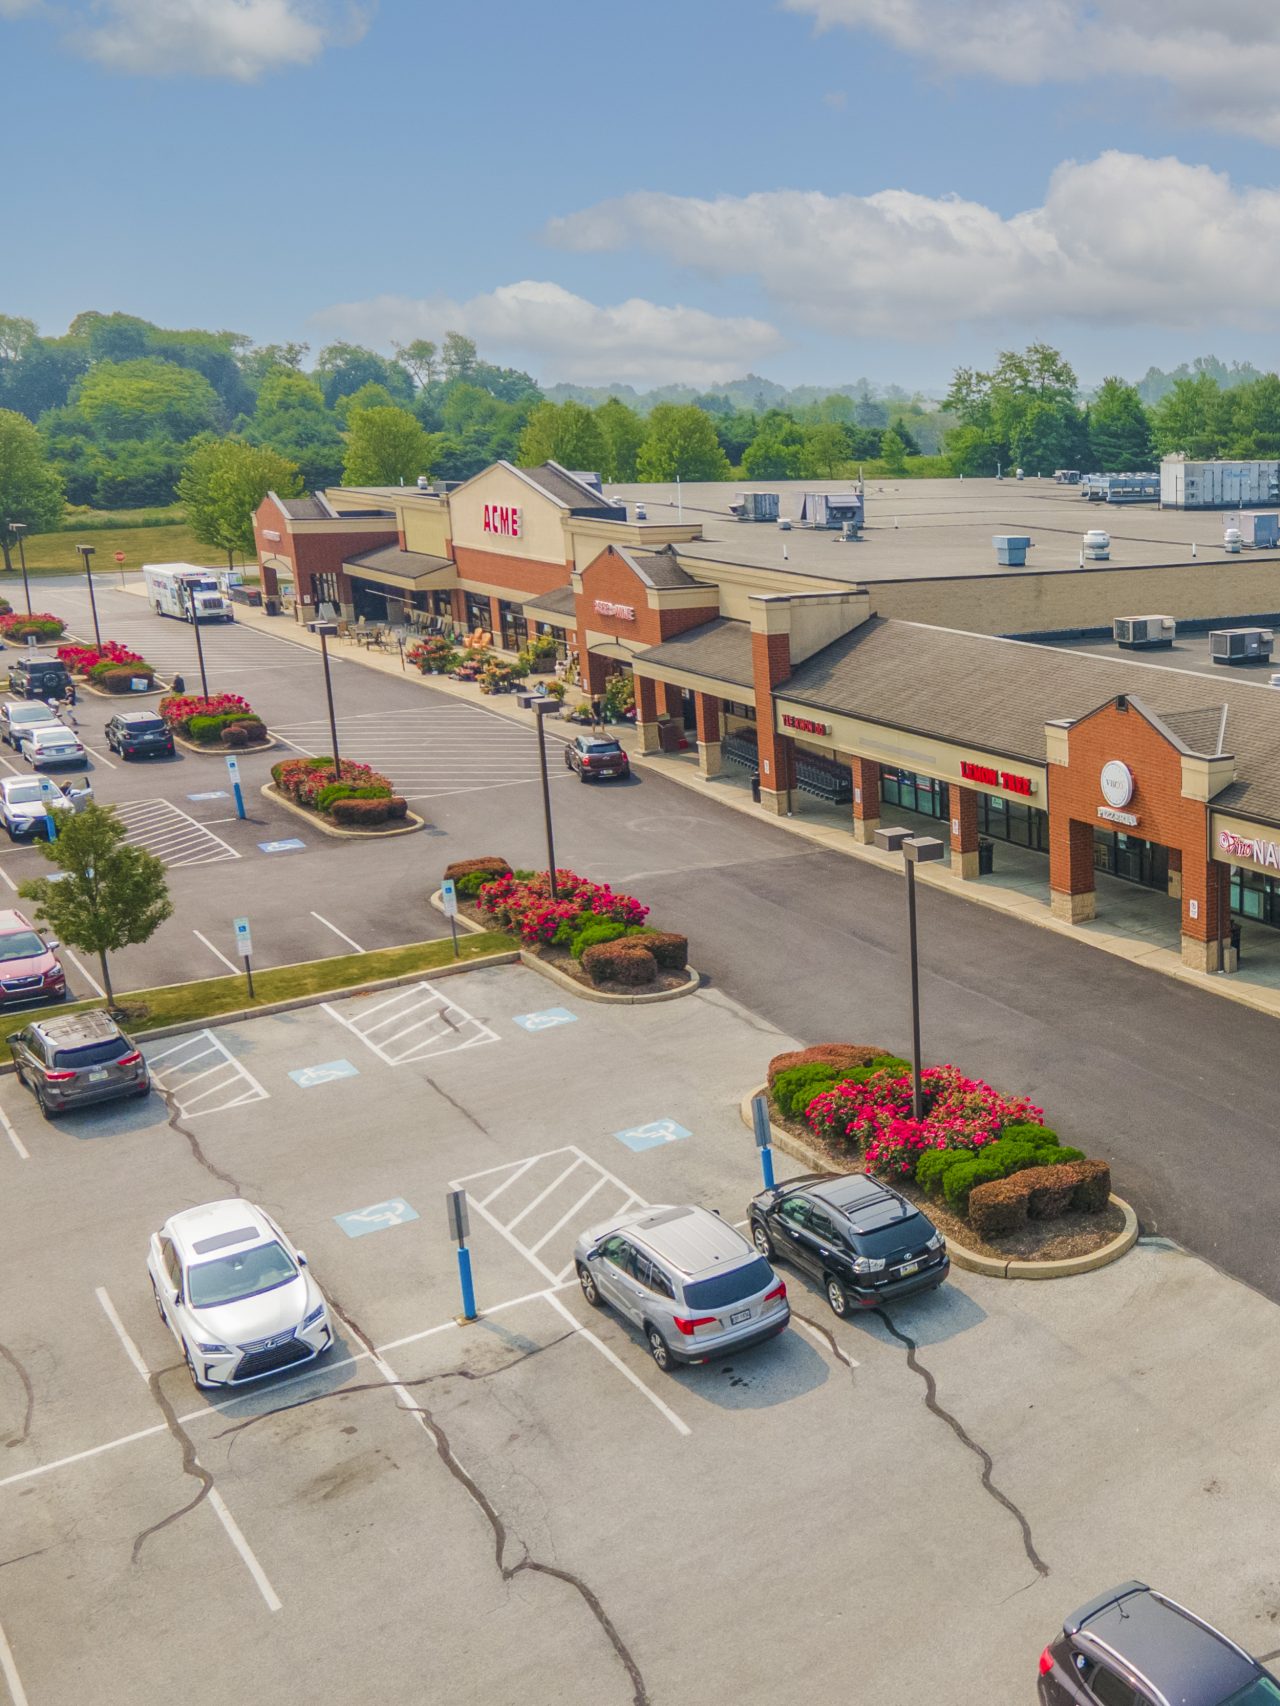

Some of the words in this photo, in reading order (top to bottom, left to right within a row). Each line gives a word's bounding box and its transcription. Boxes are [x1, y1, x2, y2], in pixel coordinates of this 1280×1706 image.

[483, 504, 519, 537] ACME
[960, 761, 998, 786] LEMON
[1001, 772, 1033, 796] TREE
